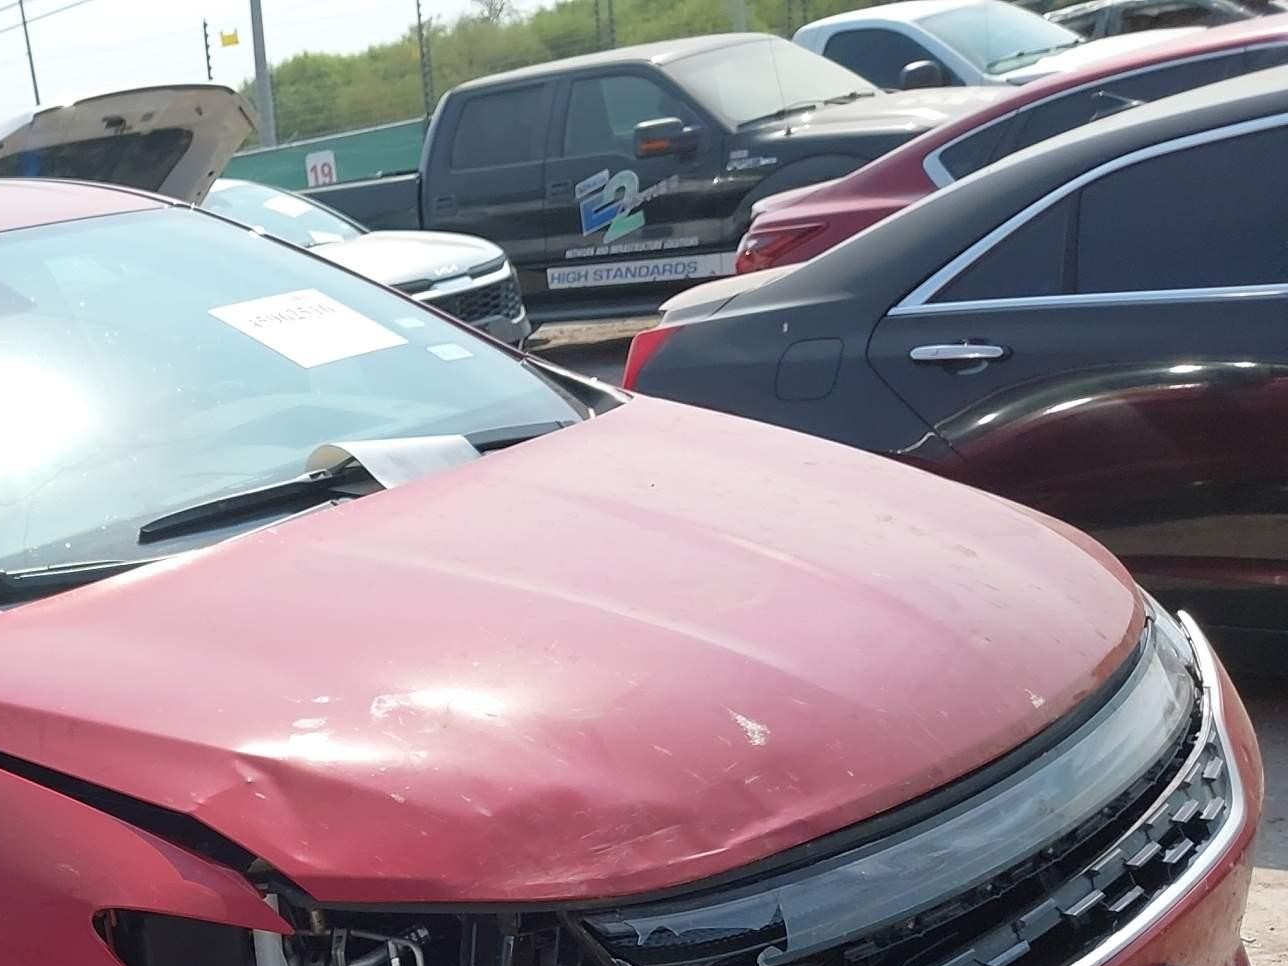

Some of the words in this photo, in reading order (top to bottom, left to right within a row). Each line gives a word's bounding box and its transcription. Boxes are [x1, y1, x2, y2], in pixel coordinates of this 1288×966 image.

[310, 162, 333, 185] 19
[550, 270, 589, 284] HIGH
[592, 261, 698, 281] STANDARDS
